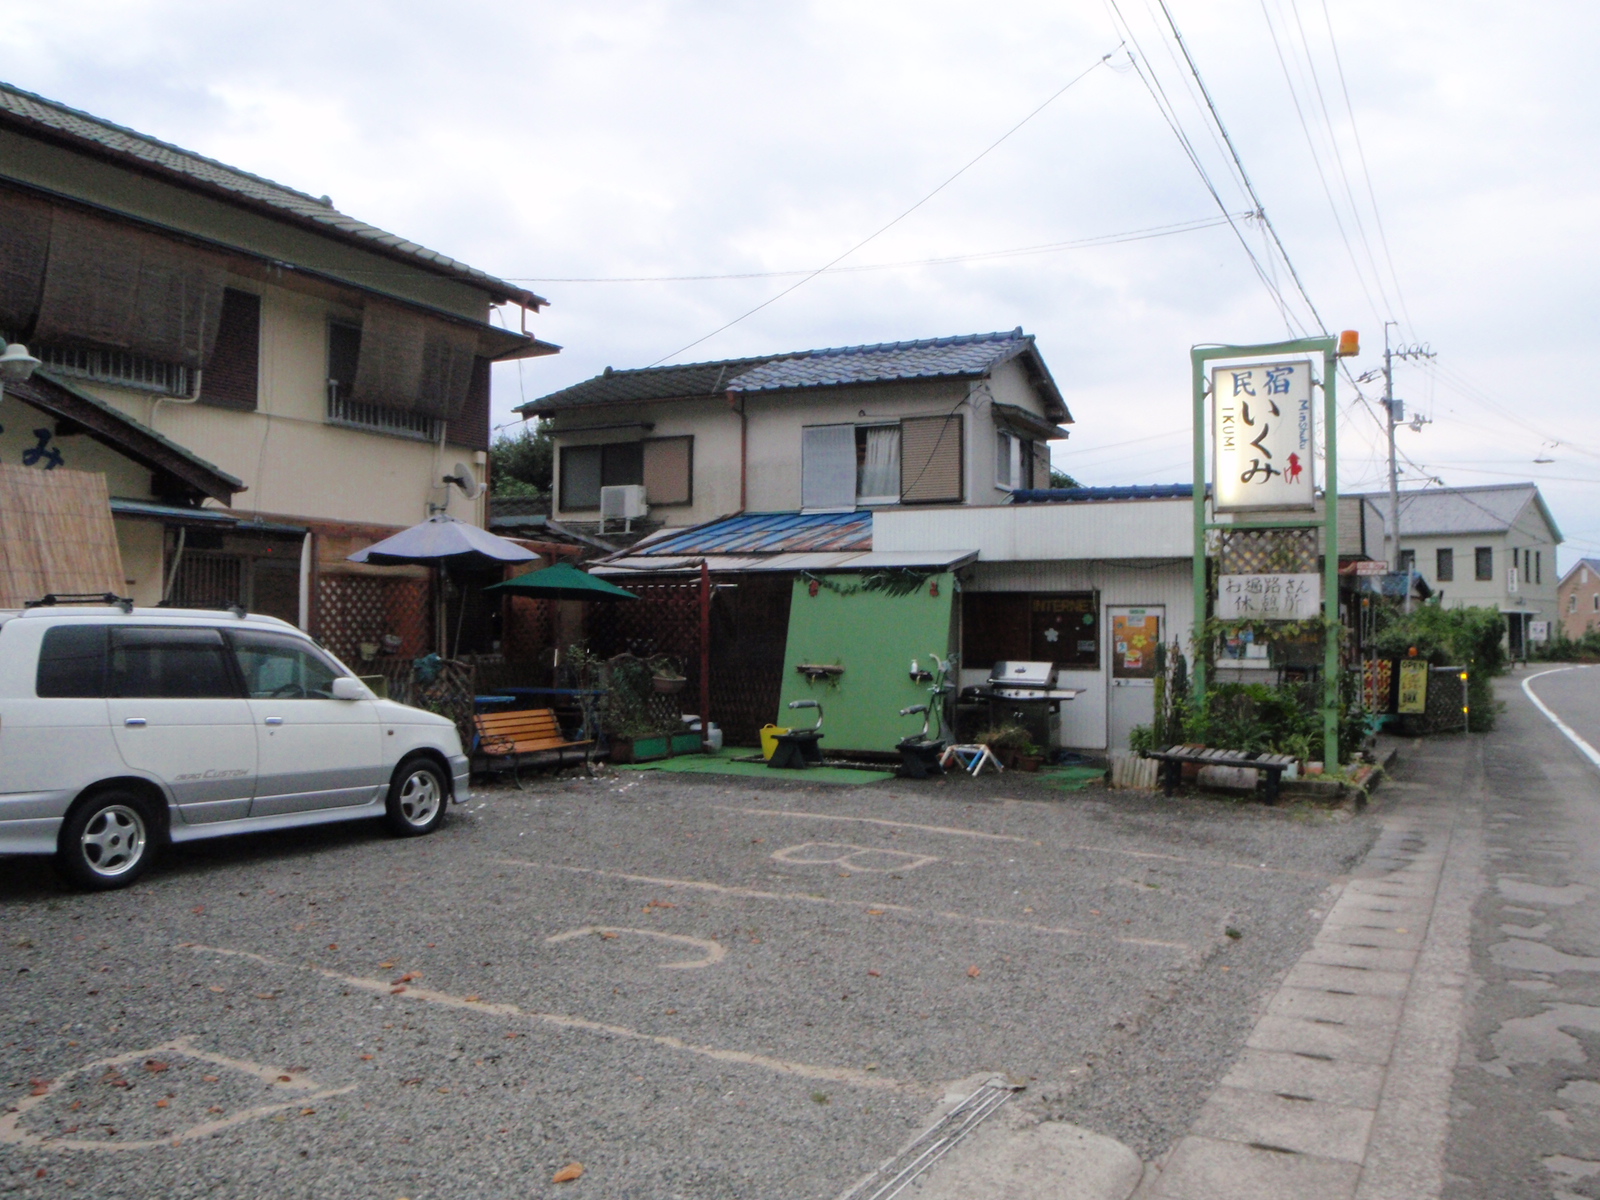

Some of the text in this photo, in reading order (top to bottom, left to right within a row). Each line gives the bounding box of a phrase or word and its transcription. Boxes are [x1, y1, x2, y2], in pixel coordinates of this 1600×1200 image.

[1230, 366, 1295, 397] 民宿
[1222, 406, 1236, 452] IKUMI
[1240, 399, 1281, 485] いくみ
[1226, 577, 1310, 594] お遍路さん
